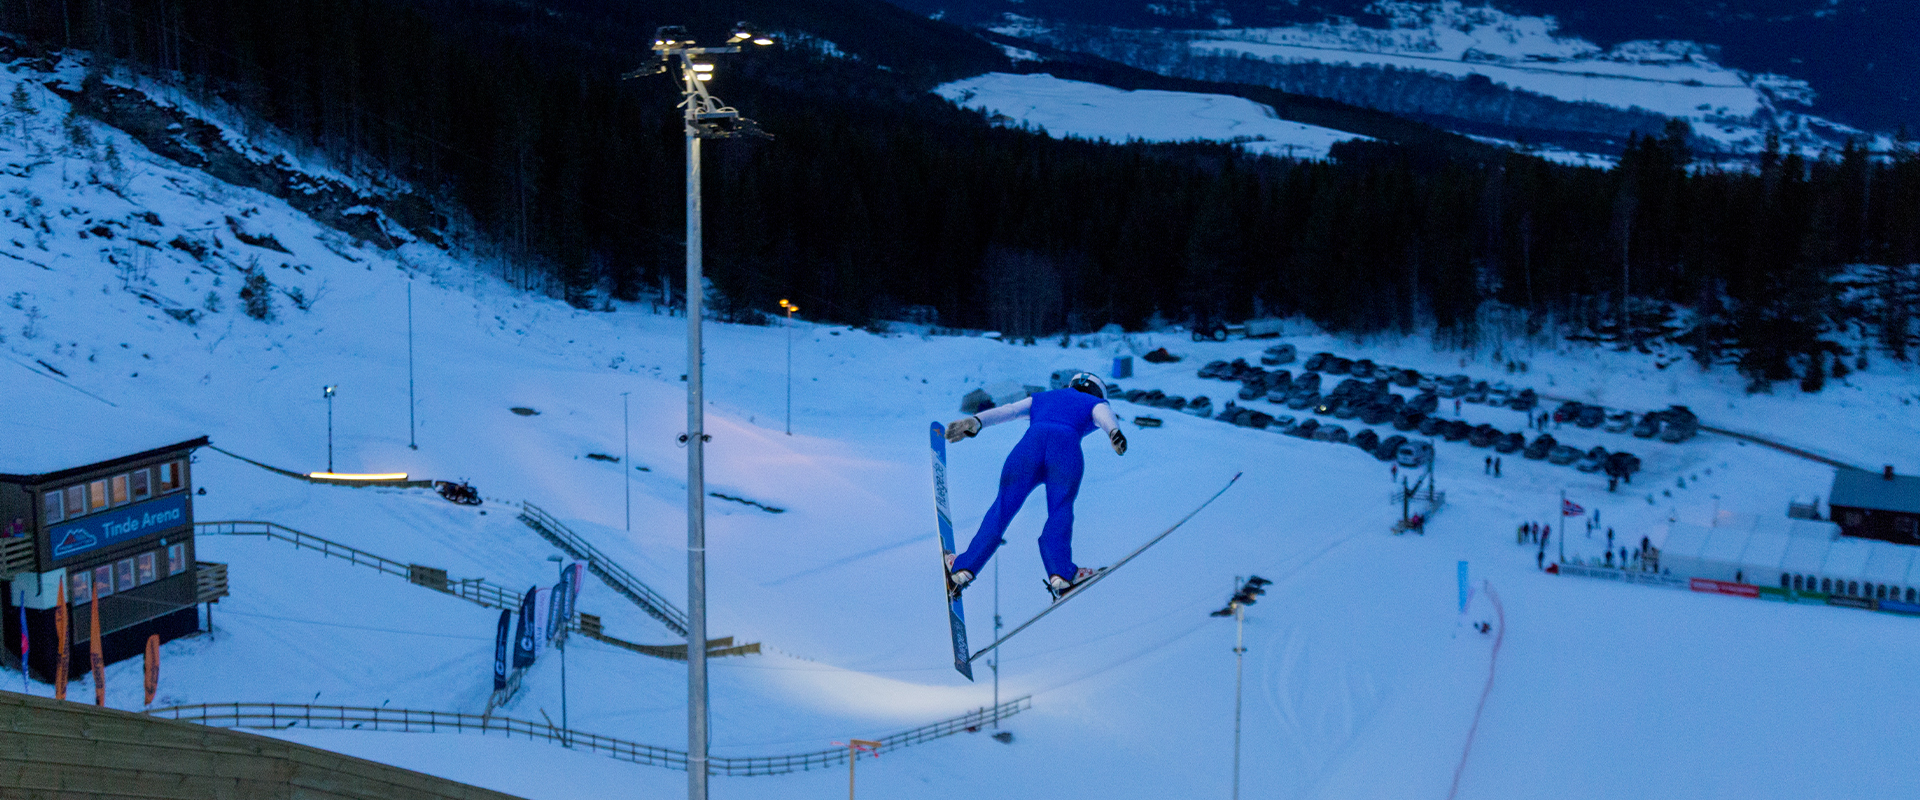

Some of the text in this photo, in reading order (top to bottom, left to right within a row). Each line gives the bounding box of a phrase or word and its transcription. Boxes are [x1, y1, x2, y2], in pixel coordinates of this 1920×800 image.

[933, 462, 948, 509] fluege.de
[101, 507, 180, 538] Tinde Arena
